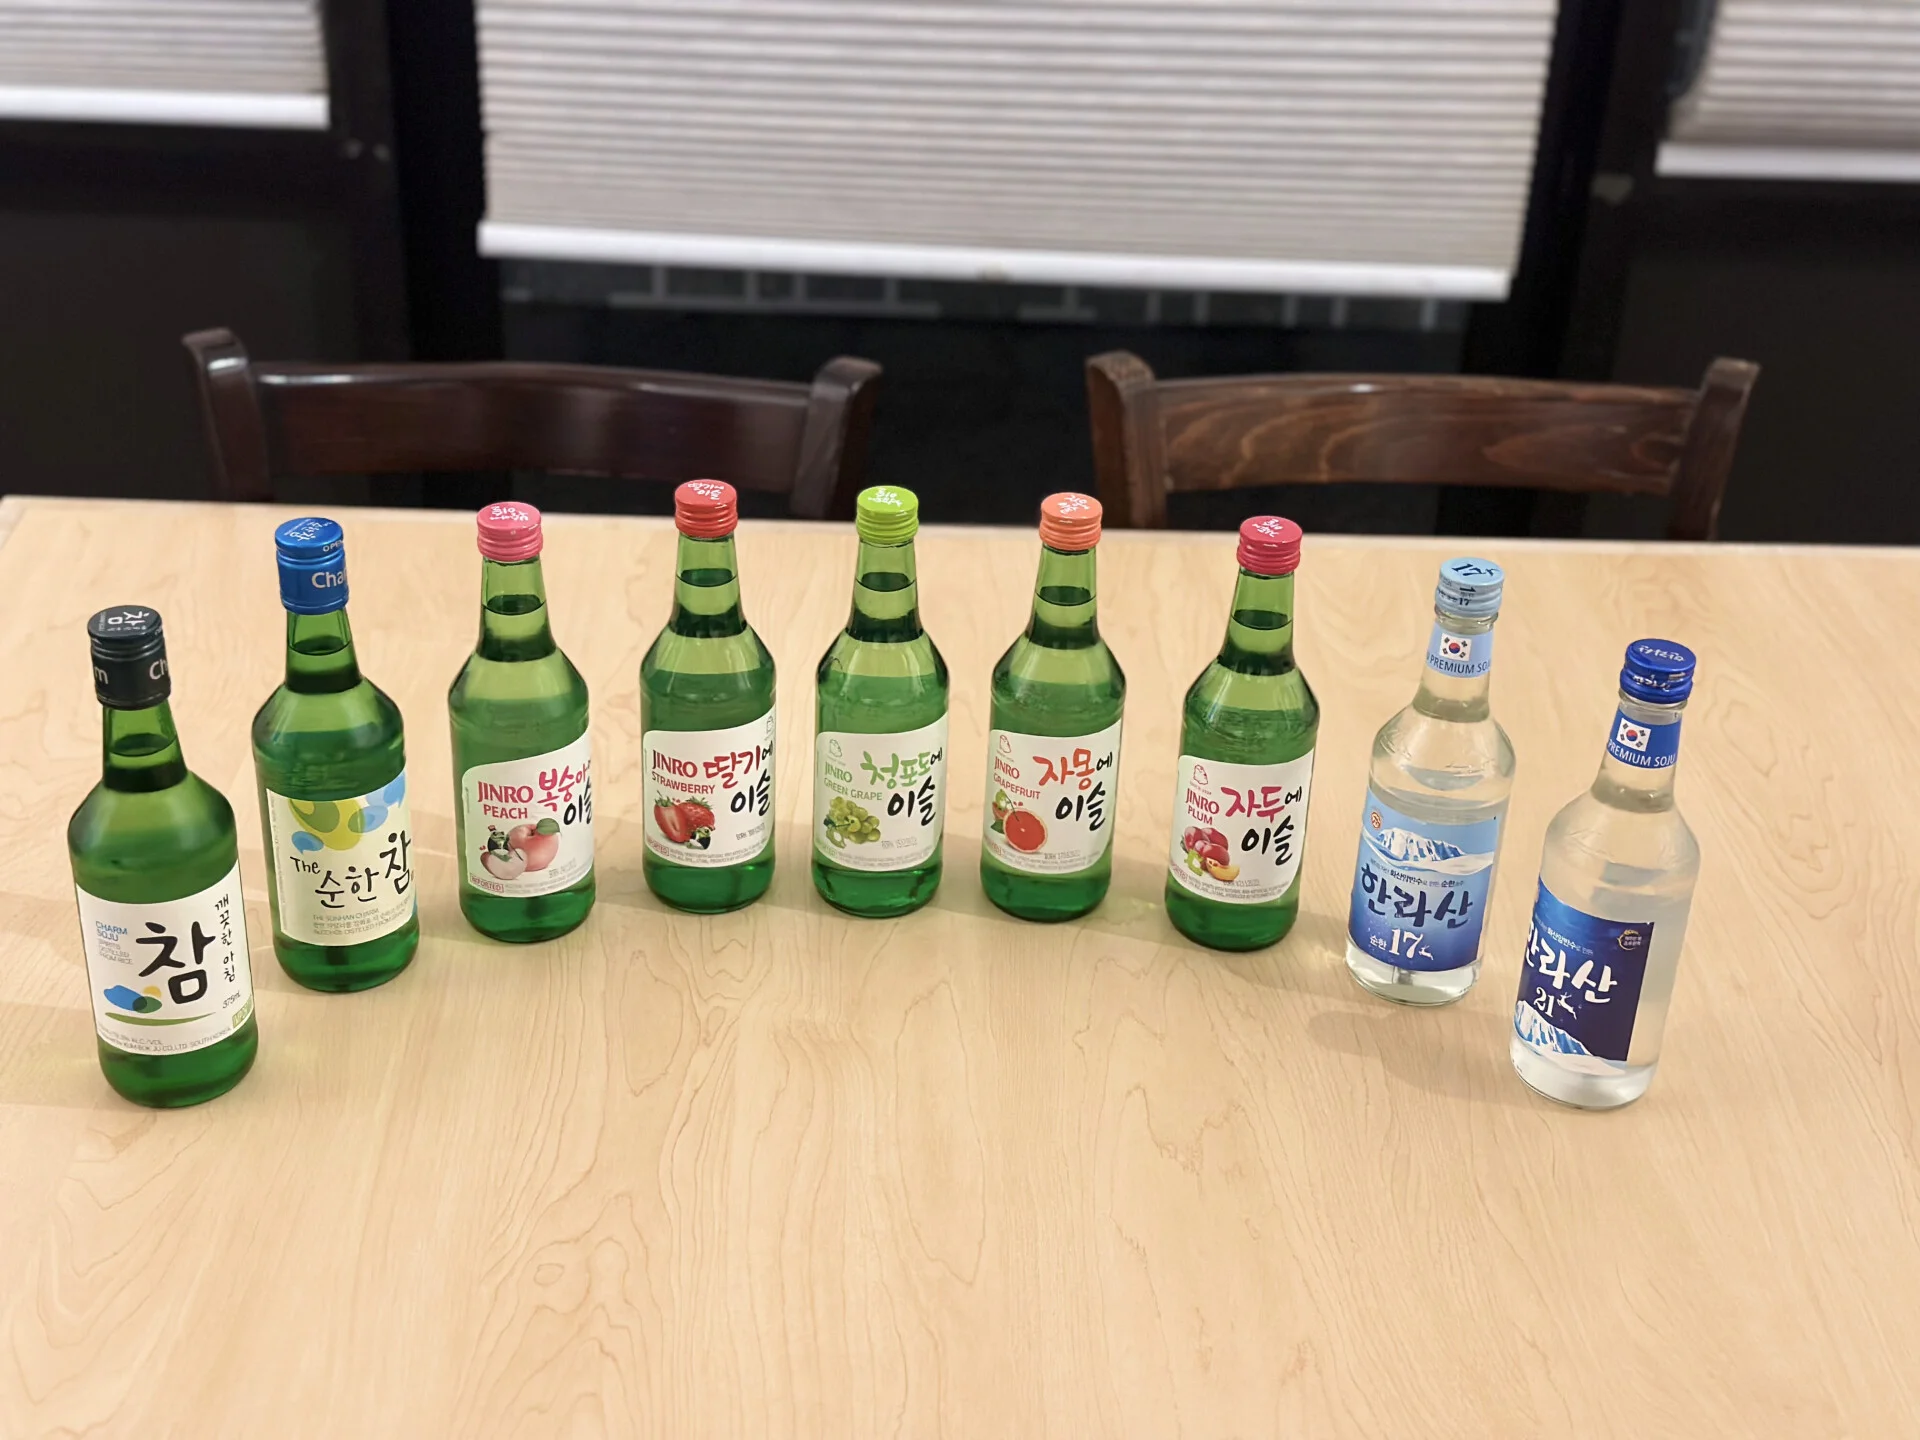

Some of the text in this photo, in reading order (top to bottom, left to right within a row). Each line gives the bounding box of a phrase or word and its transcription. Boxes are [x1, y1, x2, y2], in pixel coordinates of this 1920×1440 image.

[312, 570, 346, 589] Cha
[1430, 655, 1474, 674] PREMIUM
[653, 749, 698, 778] JINRO
[1608, 739, 1676, 767] PREMIUM SOJU
[825, 761, 852, 783] JINRO
[860, 747, 943, 790] 청포도에
[994, 756, 1020, 780] JINRO
[1032, 748, 1112, 790] 자몽에
[477, 781, 534, 803] JINRO
[537, 760, 591, 812] 복숭아
[652, 771, 715, 794] STRAWBERRY
[730, 768, 771, 816] 이슬
[824, 777, 882, 801] GREEN GRAPE
[993, 773, 1041, 800] GRAPEFRUIT
[483, 804, 528, 819] PEACH
[887, 776, 936, 826] 이슬
[1055, 781, 1106, 831] 이슬
[1185, 788, 1220, 814] JINRO
[1188, 805, 1213, 825] PLUM
[1221, 786, 1302, 823] 자두에
[1241, 815, 1294, 866] 이슬
[290, 856, 320, 874] The
[315, 866, 380, 908] 순한
[380, 830, 411, 894] 참
[1361, 862, 1474, 929] 한라산
[96, 920, 128, 935] CHARM
[97, 929, 119, 941] SOJU
[215, 894, 236, 983] 깨끗한 아침
[1369, 928, 1424, 959] 순한 17
[136, 921, 216, 1004] 참
[1533, 987, 1554, 1018] 21
